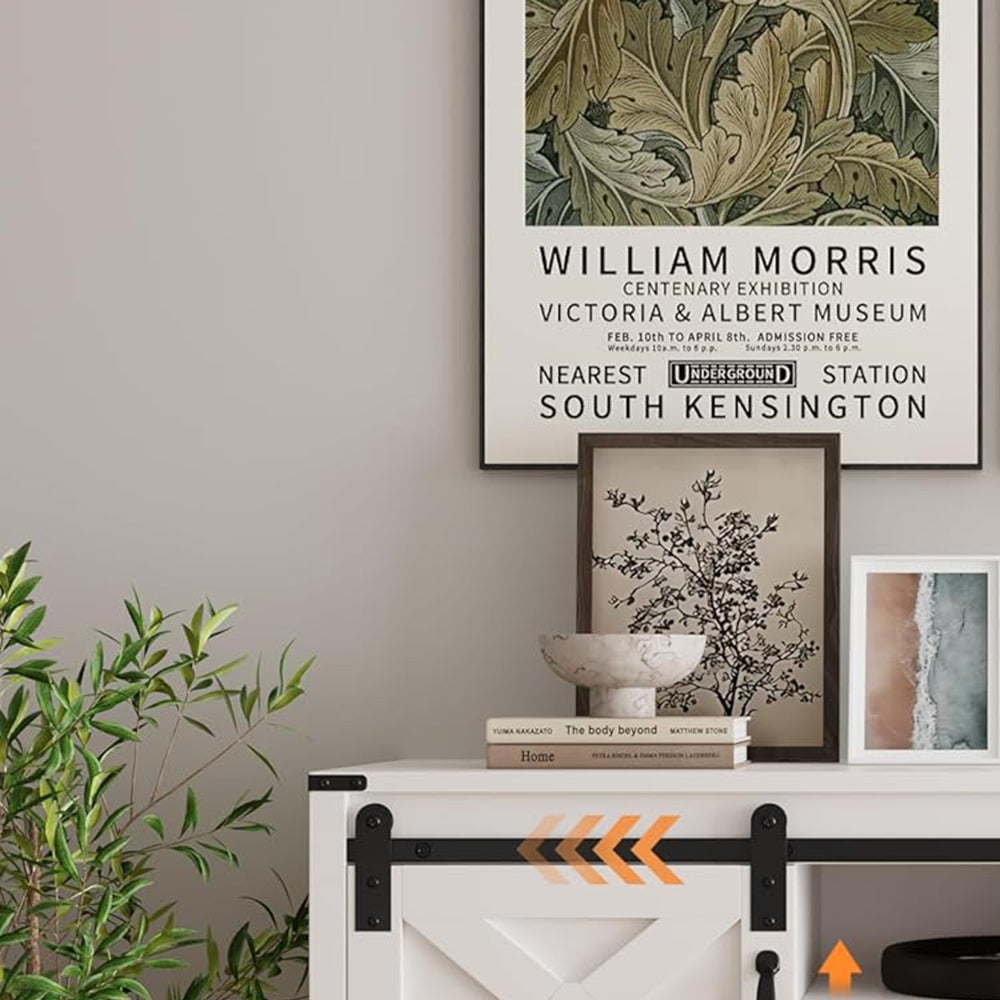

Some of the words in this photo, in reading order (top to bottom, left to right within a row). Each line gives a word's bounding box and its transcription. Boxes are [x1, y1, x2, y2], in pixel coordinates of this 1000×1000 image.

[539, 245, 728, 276] WILLIAM
[754, 245, 926, 276] MORRIS
[623, 281, 731, 297] CENTENARY
[737, 281, 843, 297] EXHIBITION
[539, 302, 665, 323] VICTORIA
[674, 302, 692, 323] &
[701, 302, 803, 323] ALBERT
[814, 302, 927, 323] MUSEUM
[607, 332, 633, 342] FEB.
[638, 332, 665, 342] 10th
[668, 332, 685, 342] TO
[688, 332, 723, 342] APRIL
[726, 332, 750, 342] 8th.
[757, 332, 825, 342] ADMISSION
[829, 332, 859, 342] FREE
[607, 344, 650, 353] Weekdays
[745, 344, 781, 353] Sundays
[539, 364, 648, 385] NEAREST
[822, 364, 926, 385] STATION
[539, 393, 664, 420] SOUTH
[685, 393, 926, 420] KENSINGTON
[566, 725, 585, 735] The
[588, 724, 615, 737] body
[618, 724, 658, 737] beyond
[669, 727, 703, 735] MATTHEW
[705, 727, 728, 735] STONE
[521, 750, 555, 763] Home
